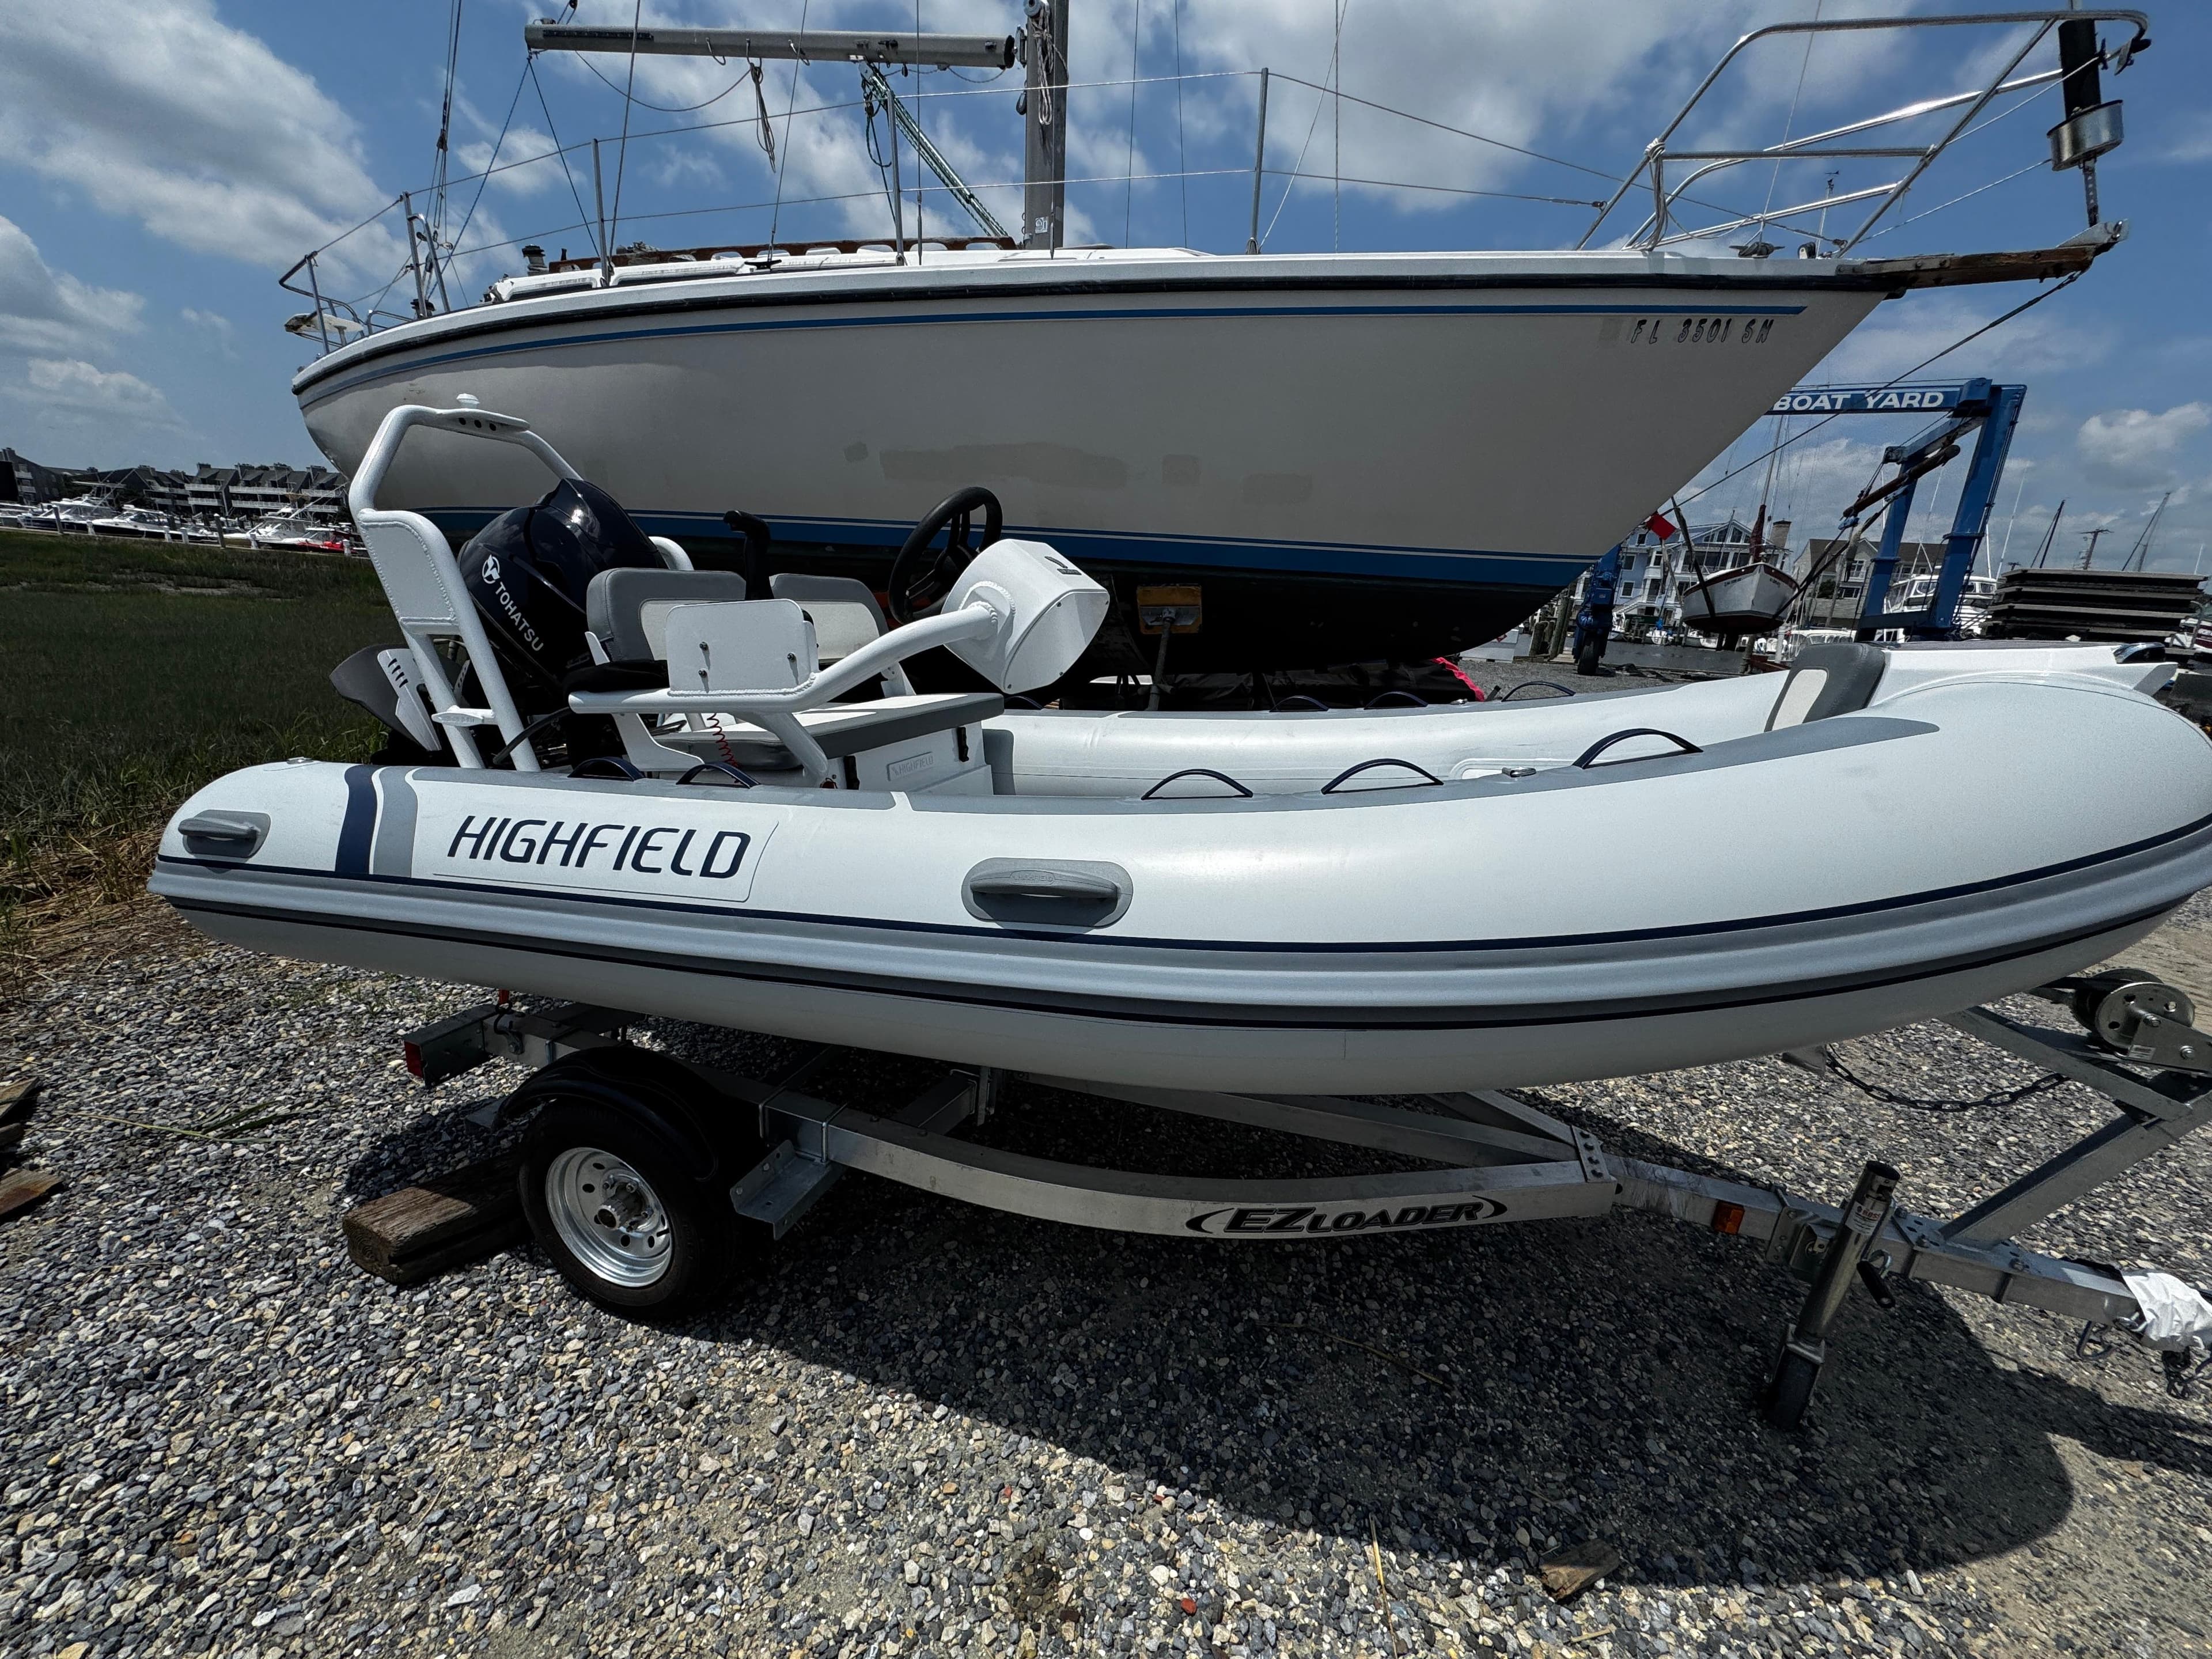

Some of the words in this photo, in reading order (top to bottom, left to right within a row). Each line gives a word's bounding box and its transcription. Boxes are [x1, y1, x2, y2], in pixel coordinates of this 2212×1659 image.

[1631, 319, 1661, 344] FL
[1677, 318, 1732, 344] 3501
[1741, 319, 1774, 344] SN
[1772, 394, 1851, 411] BOAT
[1865, 392, 1944, 408] YARD
[495, 581, 544, 652] TOHATSU
[447, 815, 751, 879] HIGHFIELD
